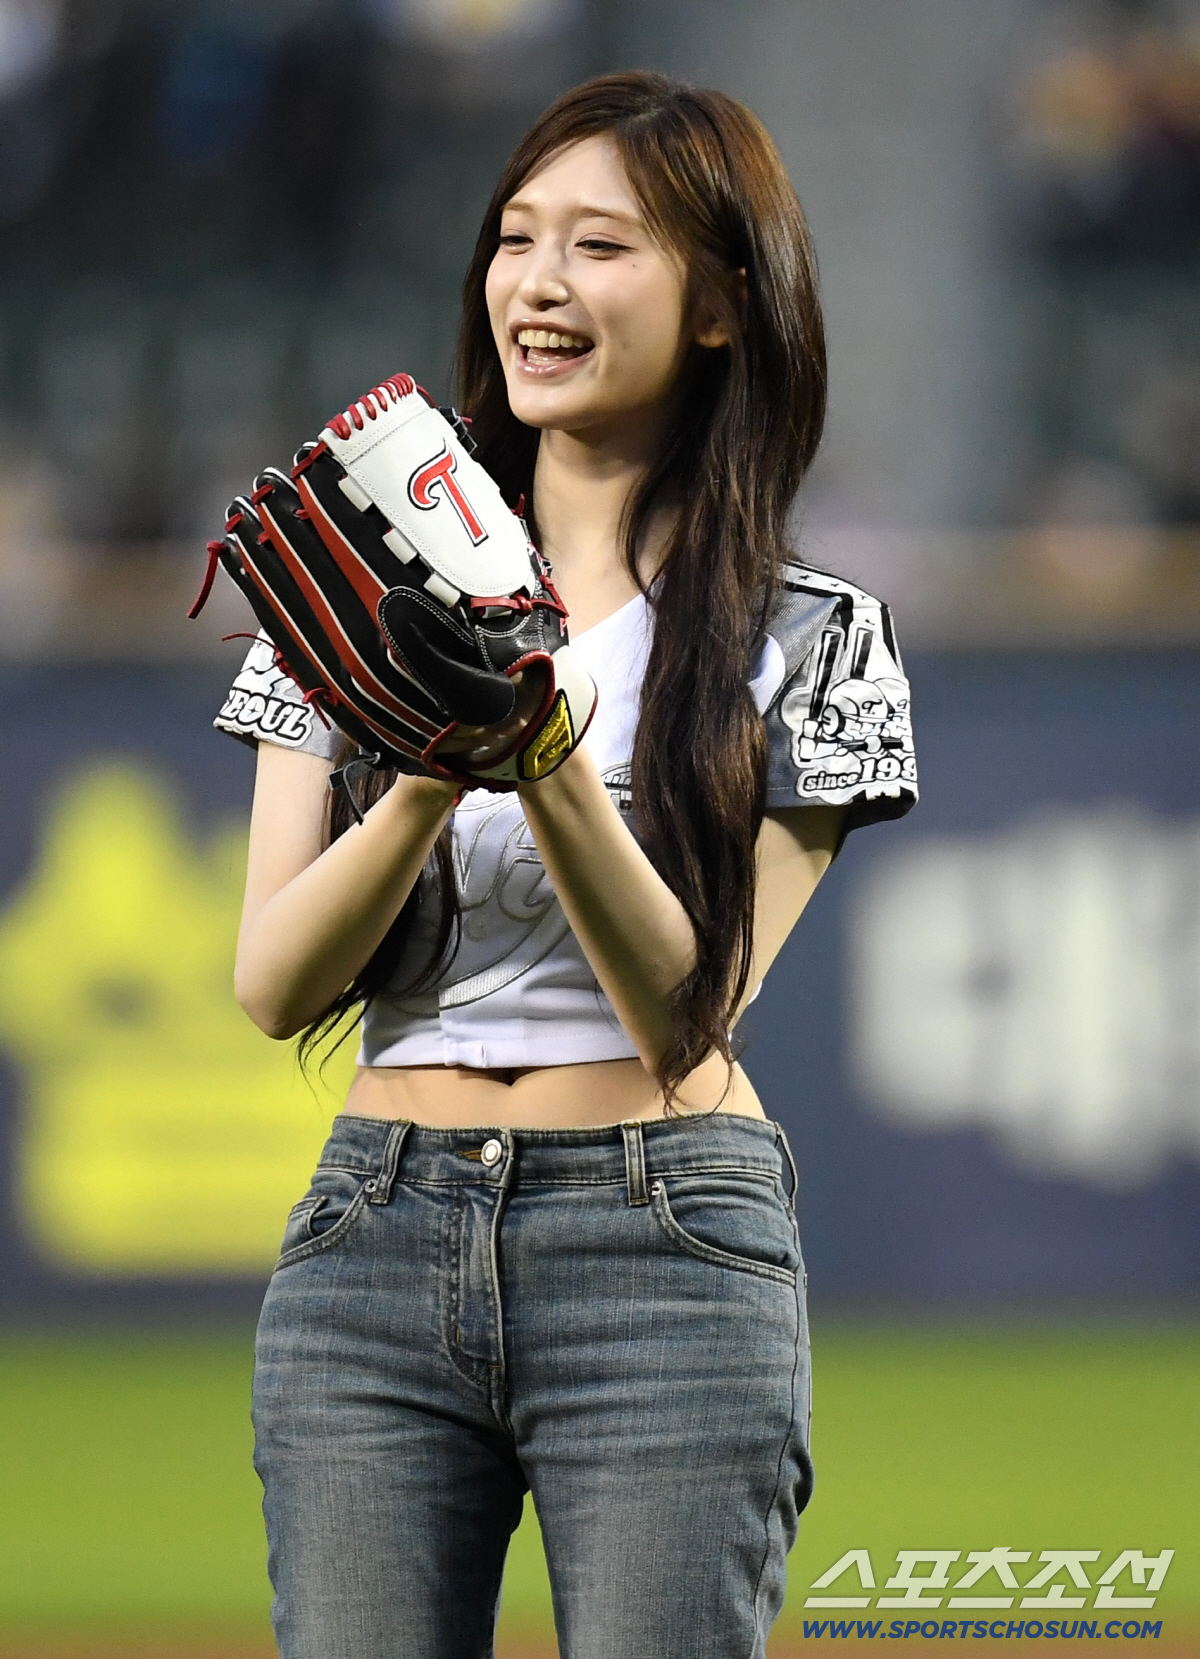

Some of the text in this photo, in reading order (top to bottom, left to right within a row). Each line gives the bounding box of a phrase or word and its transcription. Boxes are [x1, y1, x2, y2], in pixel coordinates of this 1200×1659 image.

[407, 437, 489, 547] T
[219, 686, 310, 740] EOUL
[803, 771, 860, 791] since
